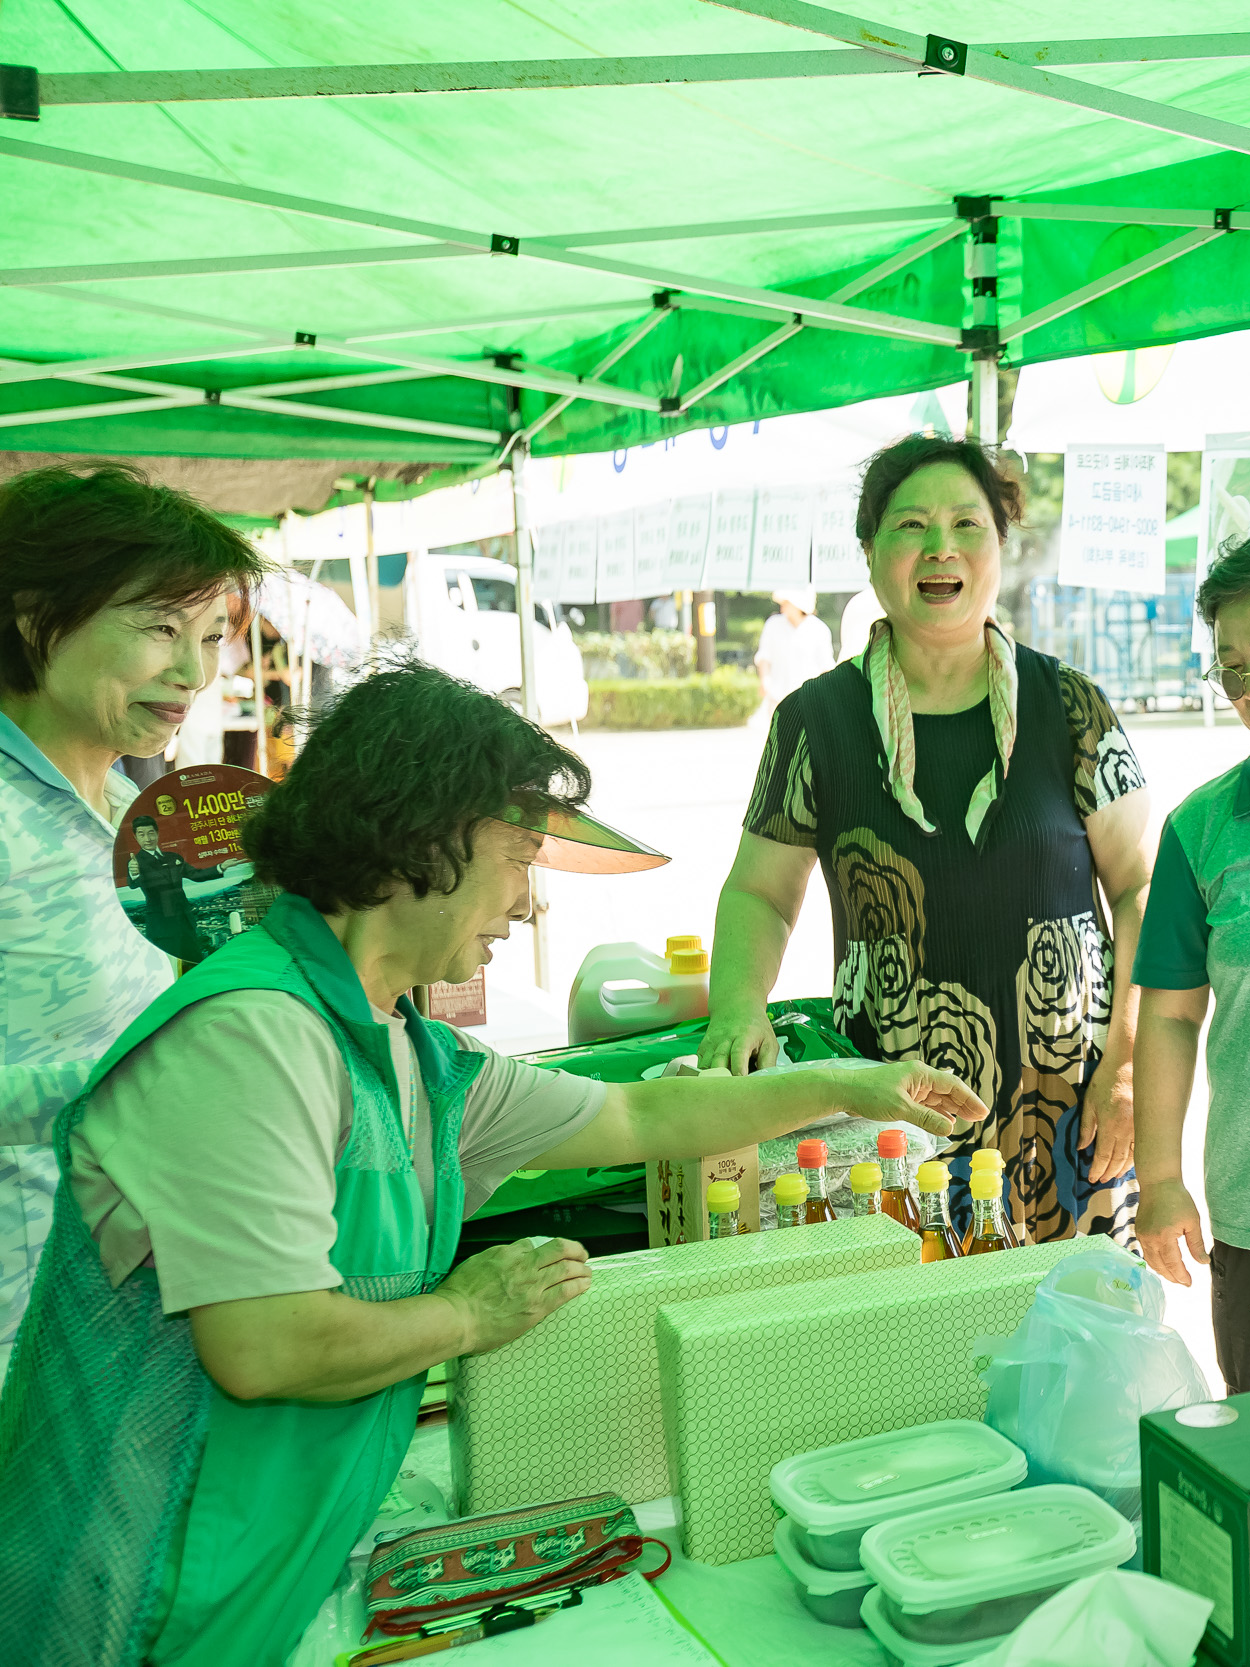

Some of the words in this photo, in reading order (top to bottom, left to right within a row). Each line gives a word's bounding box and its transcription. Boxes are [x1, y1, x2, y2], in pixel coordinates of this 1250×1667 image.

[183, 790, 246, 819] 1,400만
[245, 795, 266, 808] 관광
[717, 1158, 736, 1168] 100%
